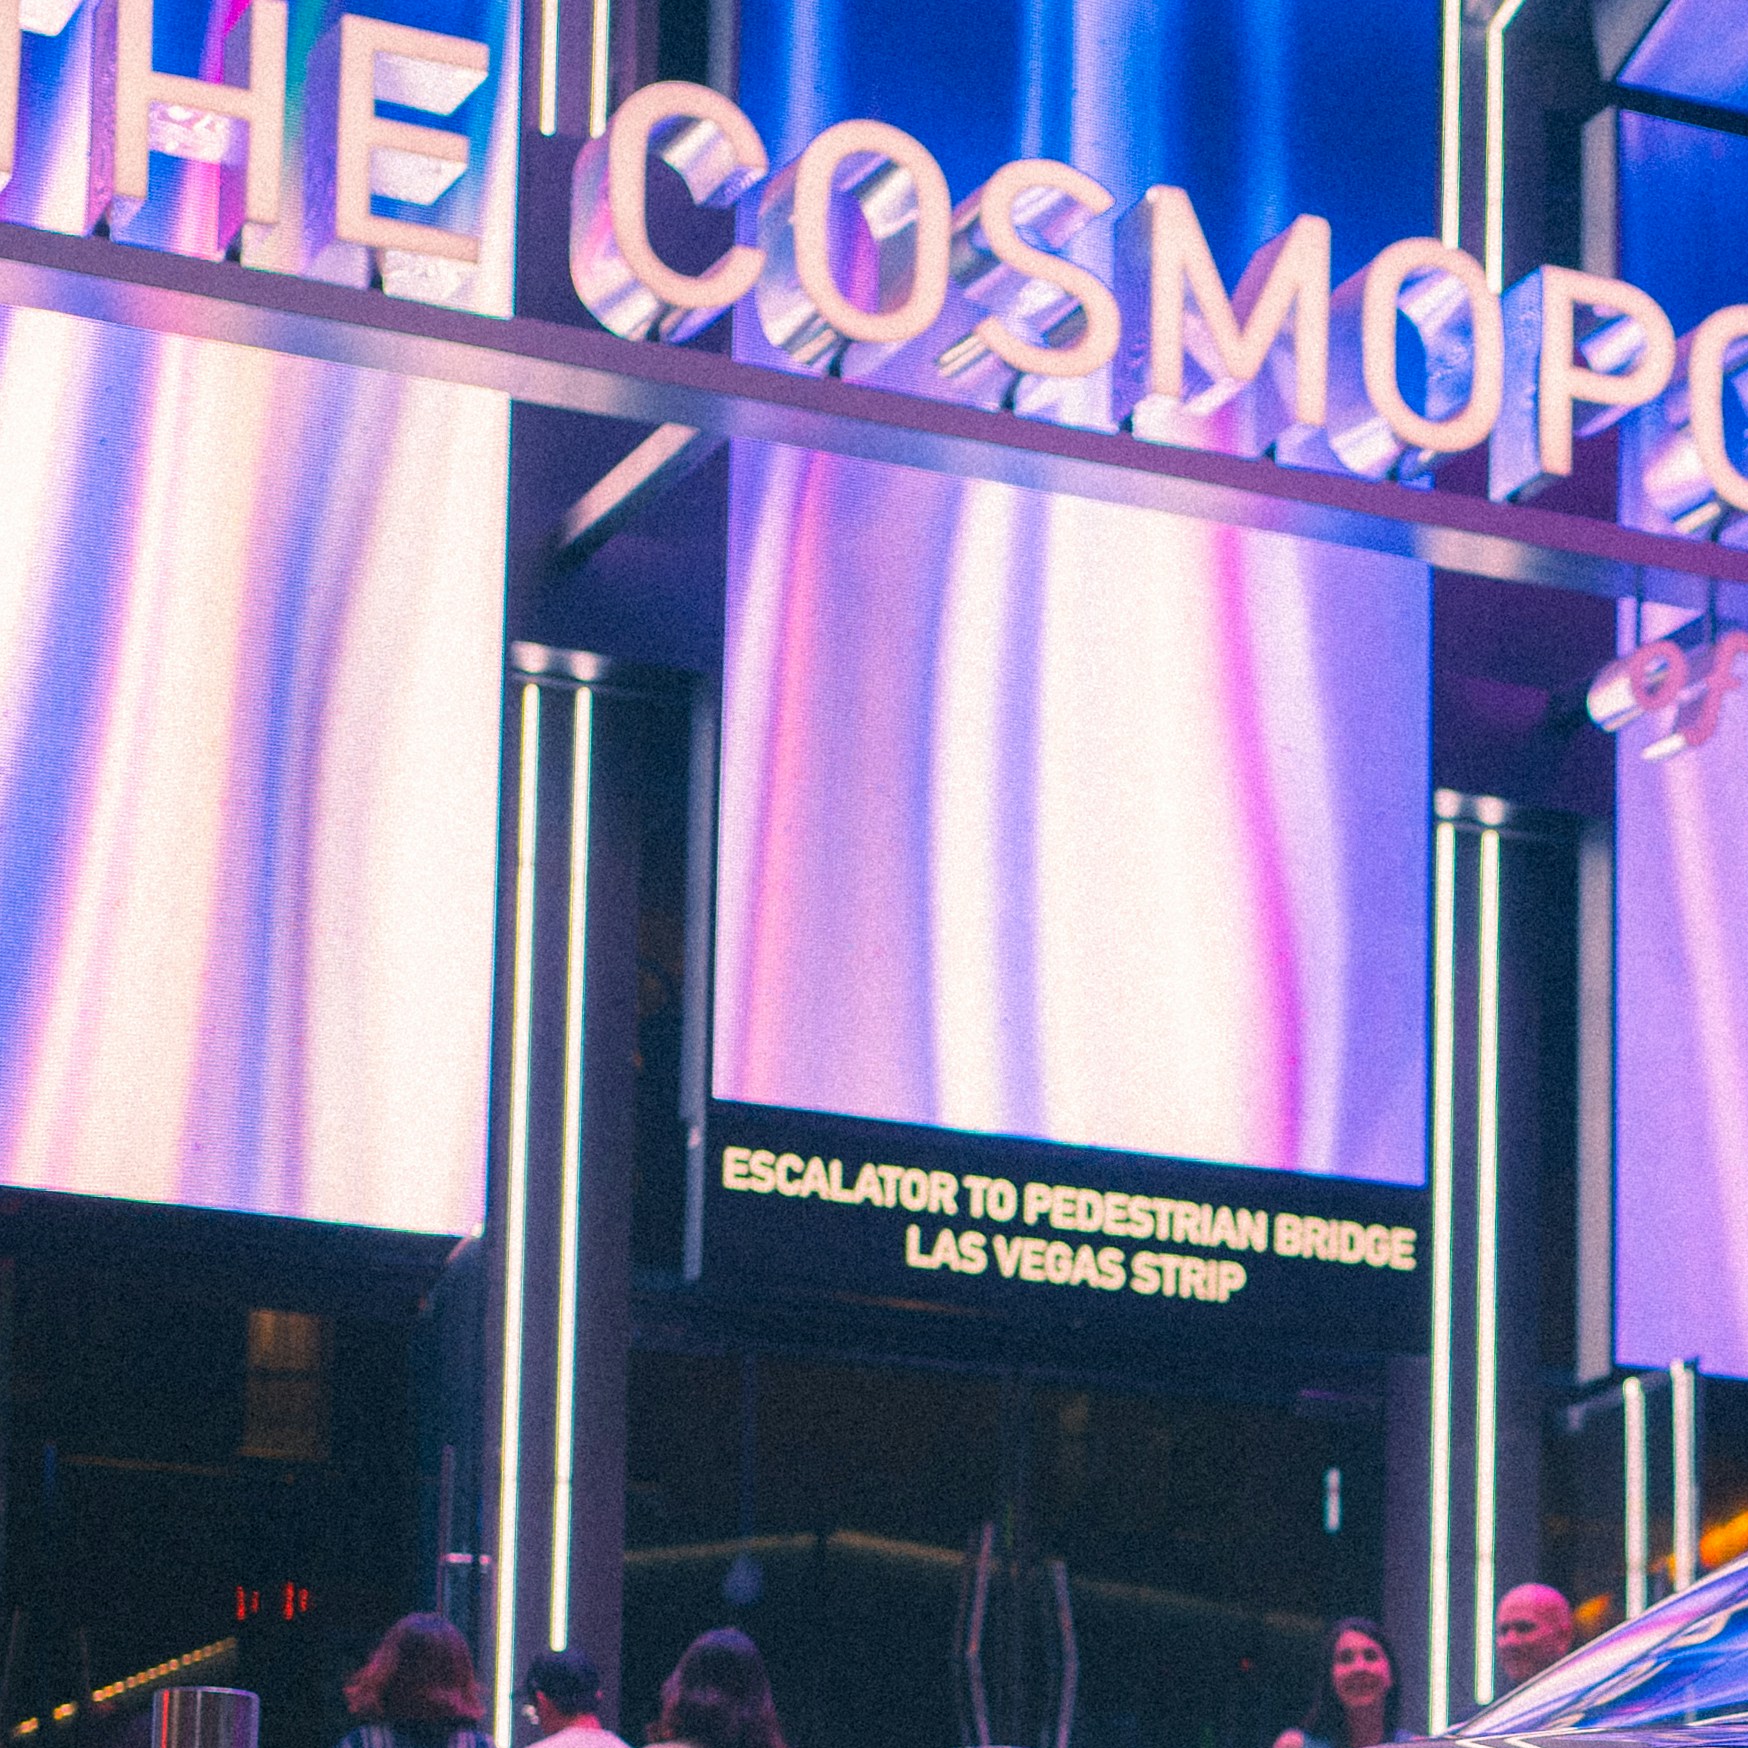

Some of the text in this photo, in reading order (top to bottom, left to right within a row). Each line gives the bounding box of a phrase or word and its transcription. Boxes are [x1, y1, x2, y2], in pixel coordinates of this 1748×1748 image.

[0, 0, 489, 263] HE
[722, 1147, 1417, 1270] ESCALATOR TO PEDESTRIAN BRIDGE
[905, 1223, 1248, 1303] LAS VEGAS STRIP
